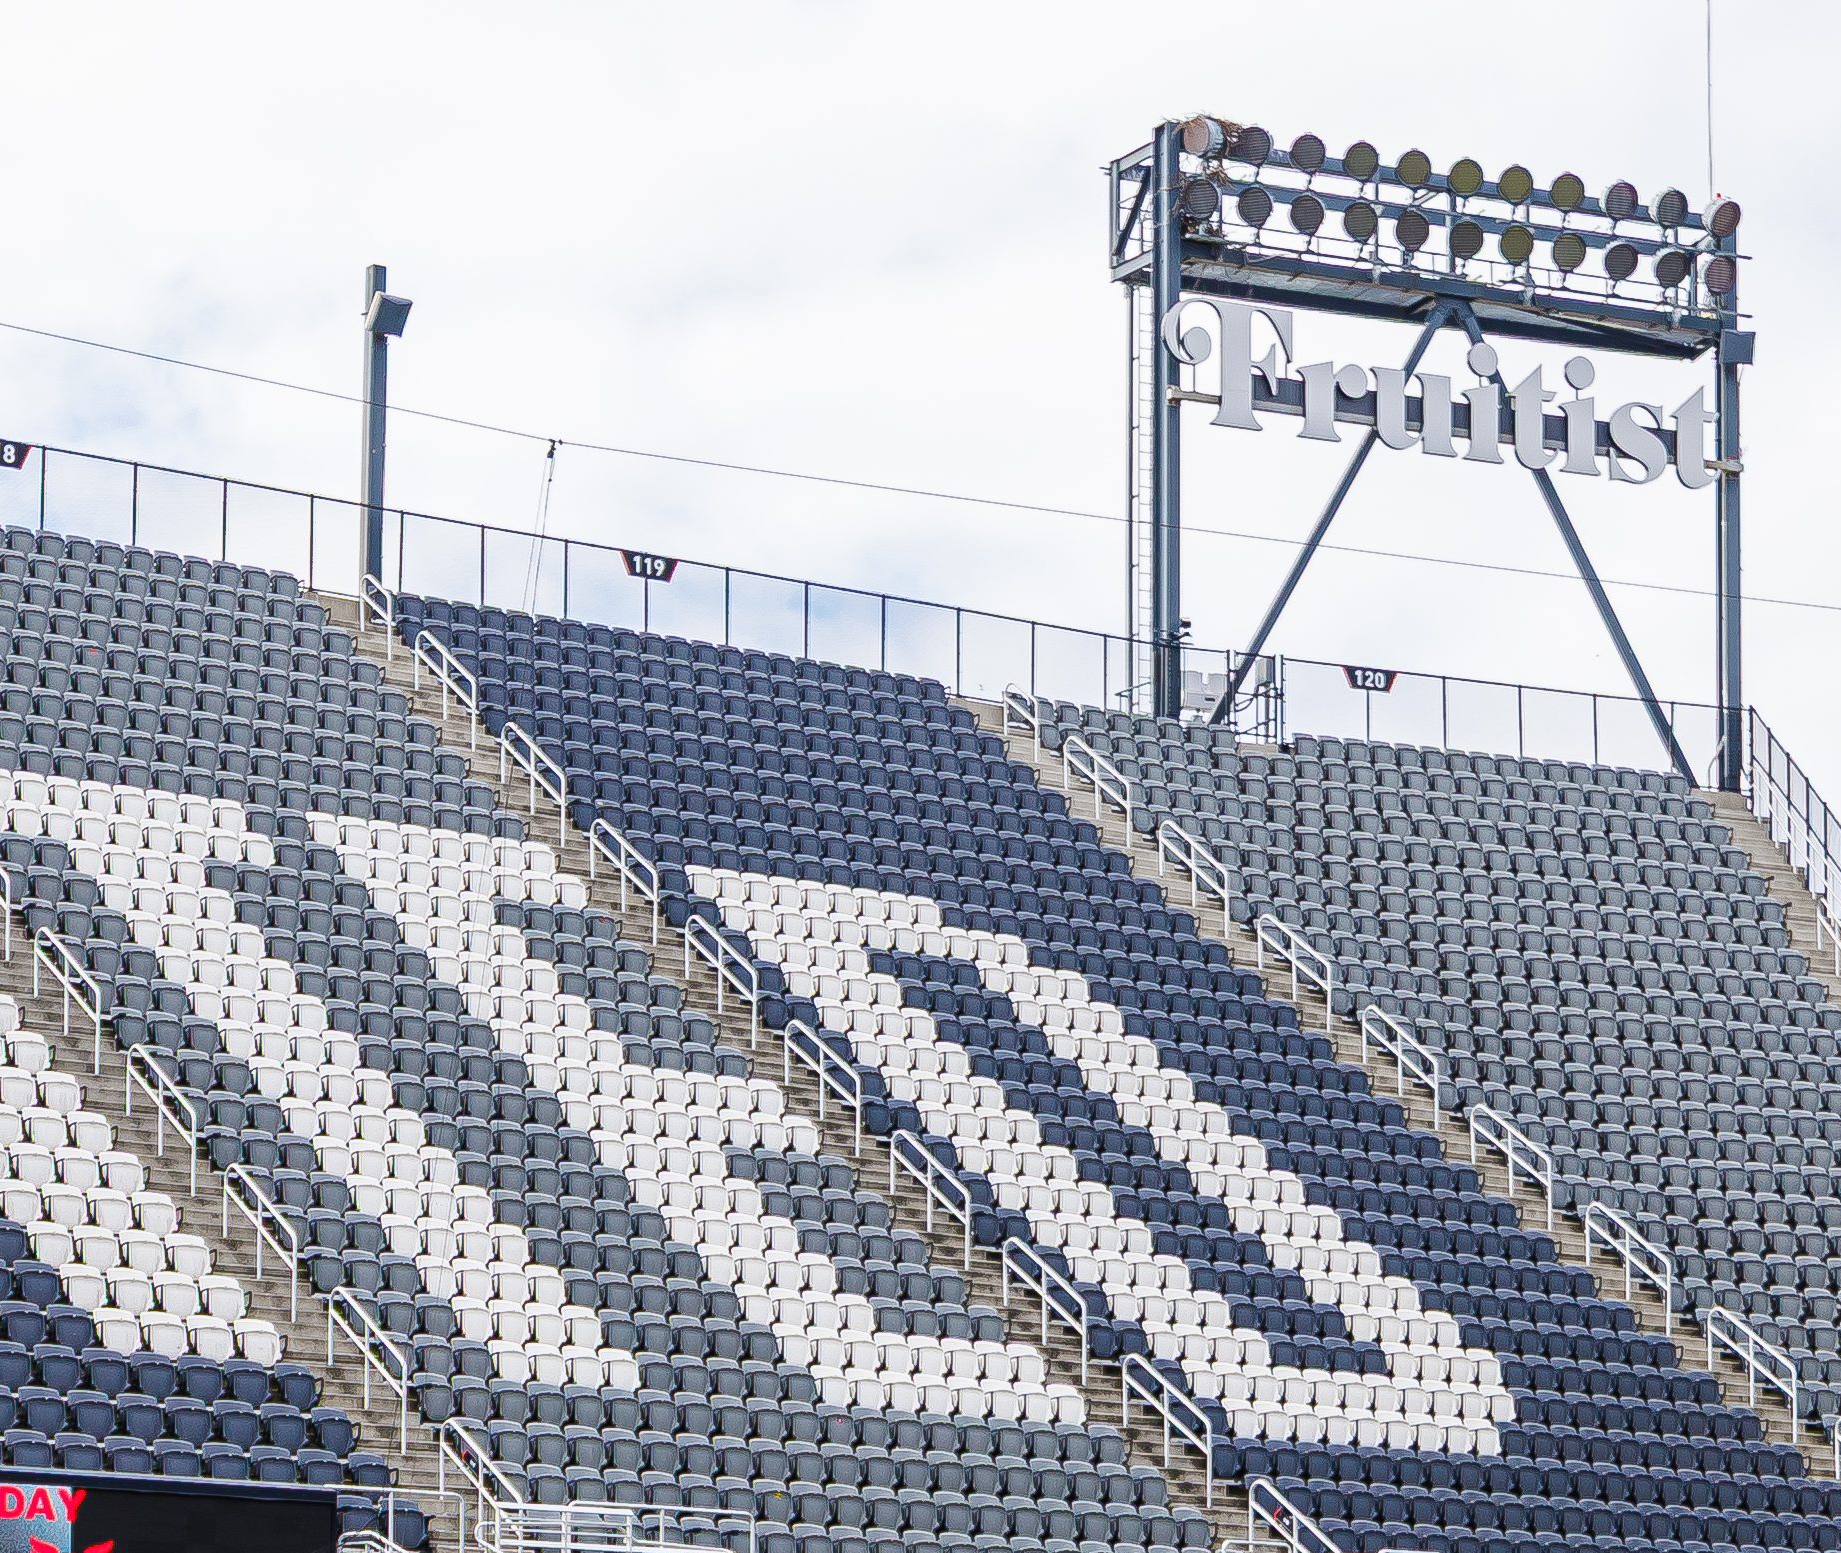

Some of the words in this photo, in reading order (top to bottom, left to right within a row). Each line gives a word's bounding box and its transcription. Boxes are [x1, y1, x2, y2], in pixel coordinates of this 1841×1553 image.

[1162, 297, 1720, 490] Fruitist
[633, 555, 666, 577] 119
[1354, 669, 1386, 689] 120
